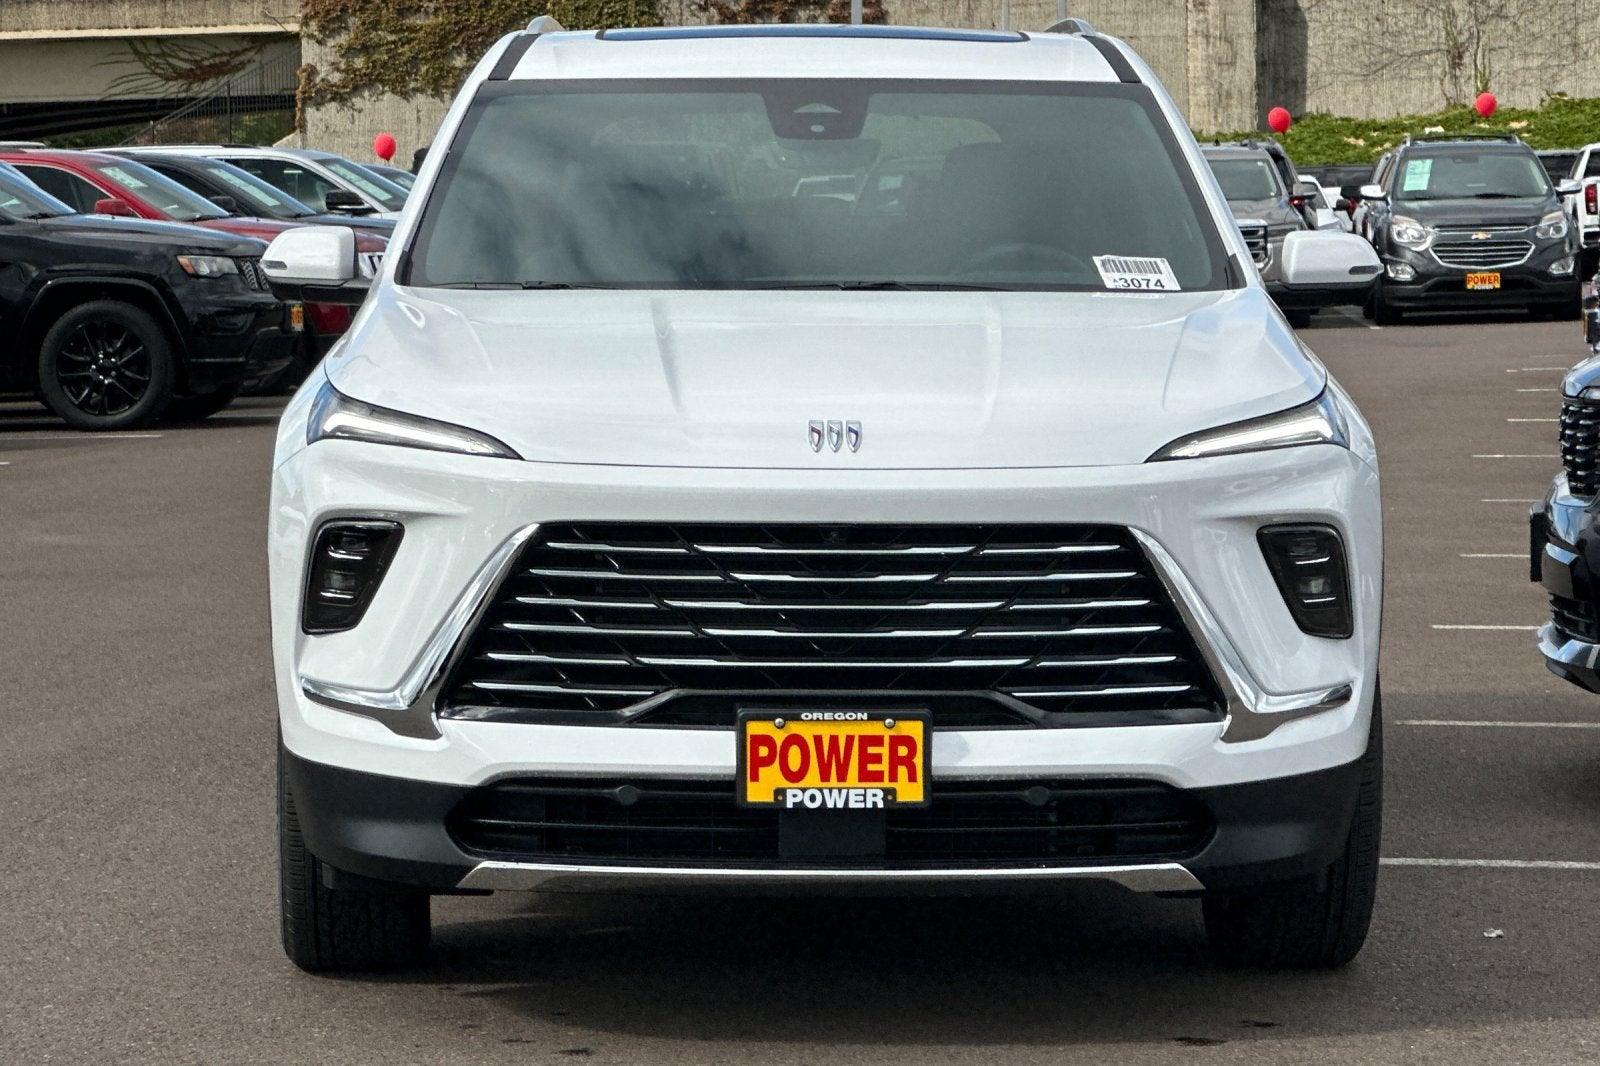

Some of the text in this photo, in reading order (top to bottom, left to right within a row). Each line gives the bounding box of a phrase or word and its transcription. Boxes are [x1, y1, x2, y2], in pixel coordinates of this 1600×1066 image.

[1467, 275, 1500, 285] POWER
[801, 712, 868, 720] OREGON
[749, 733, 918, 783] POWER
[786, 788, 884, 809] POWER
